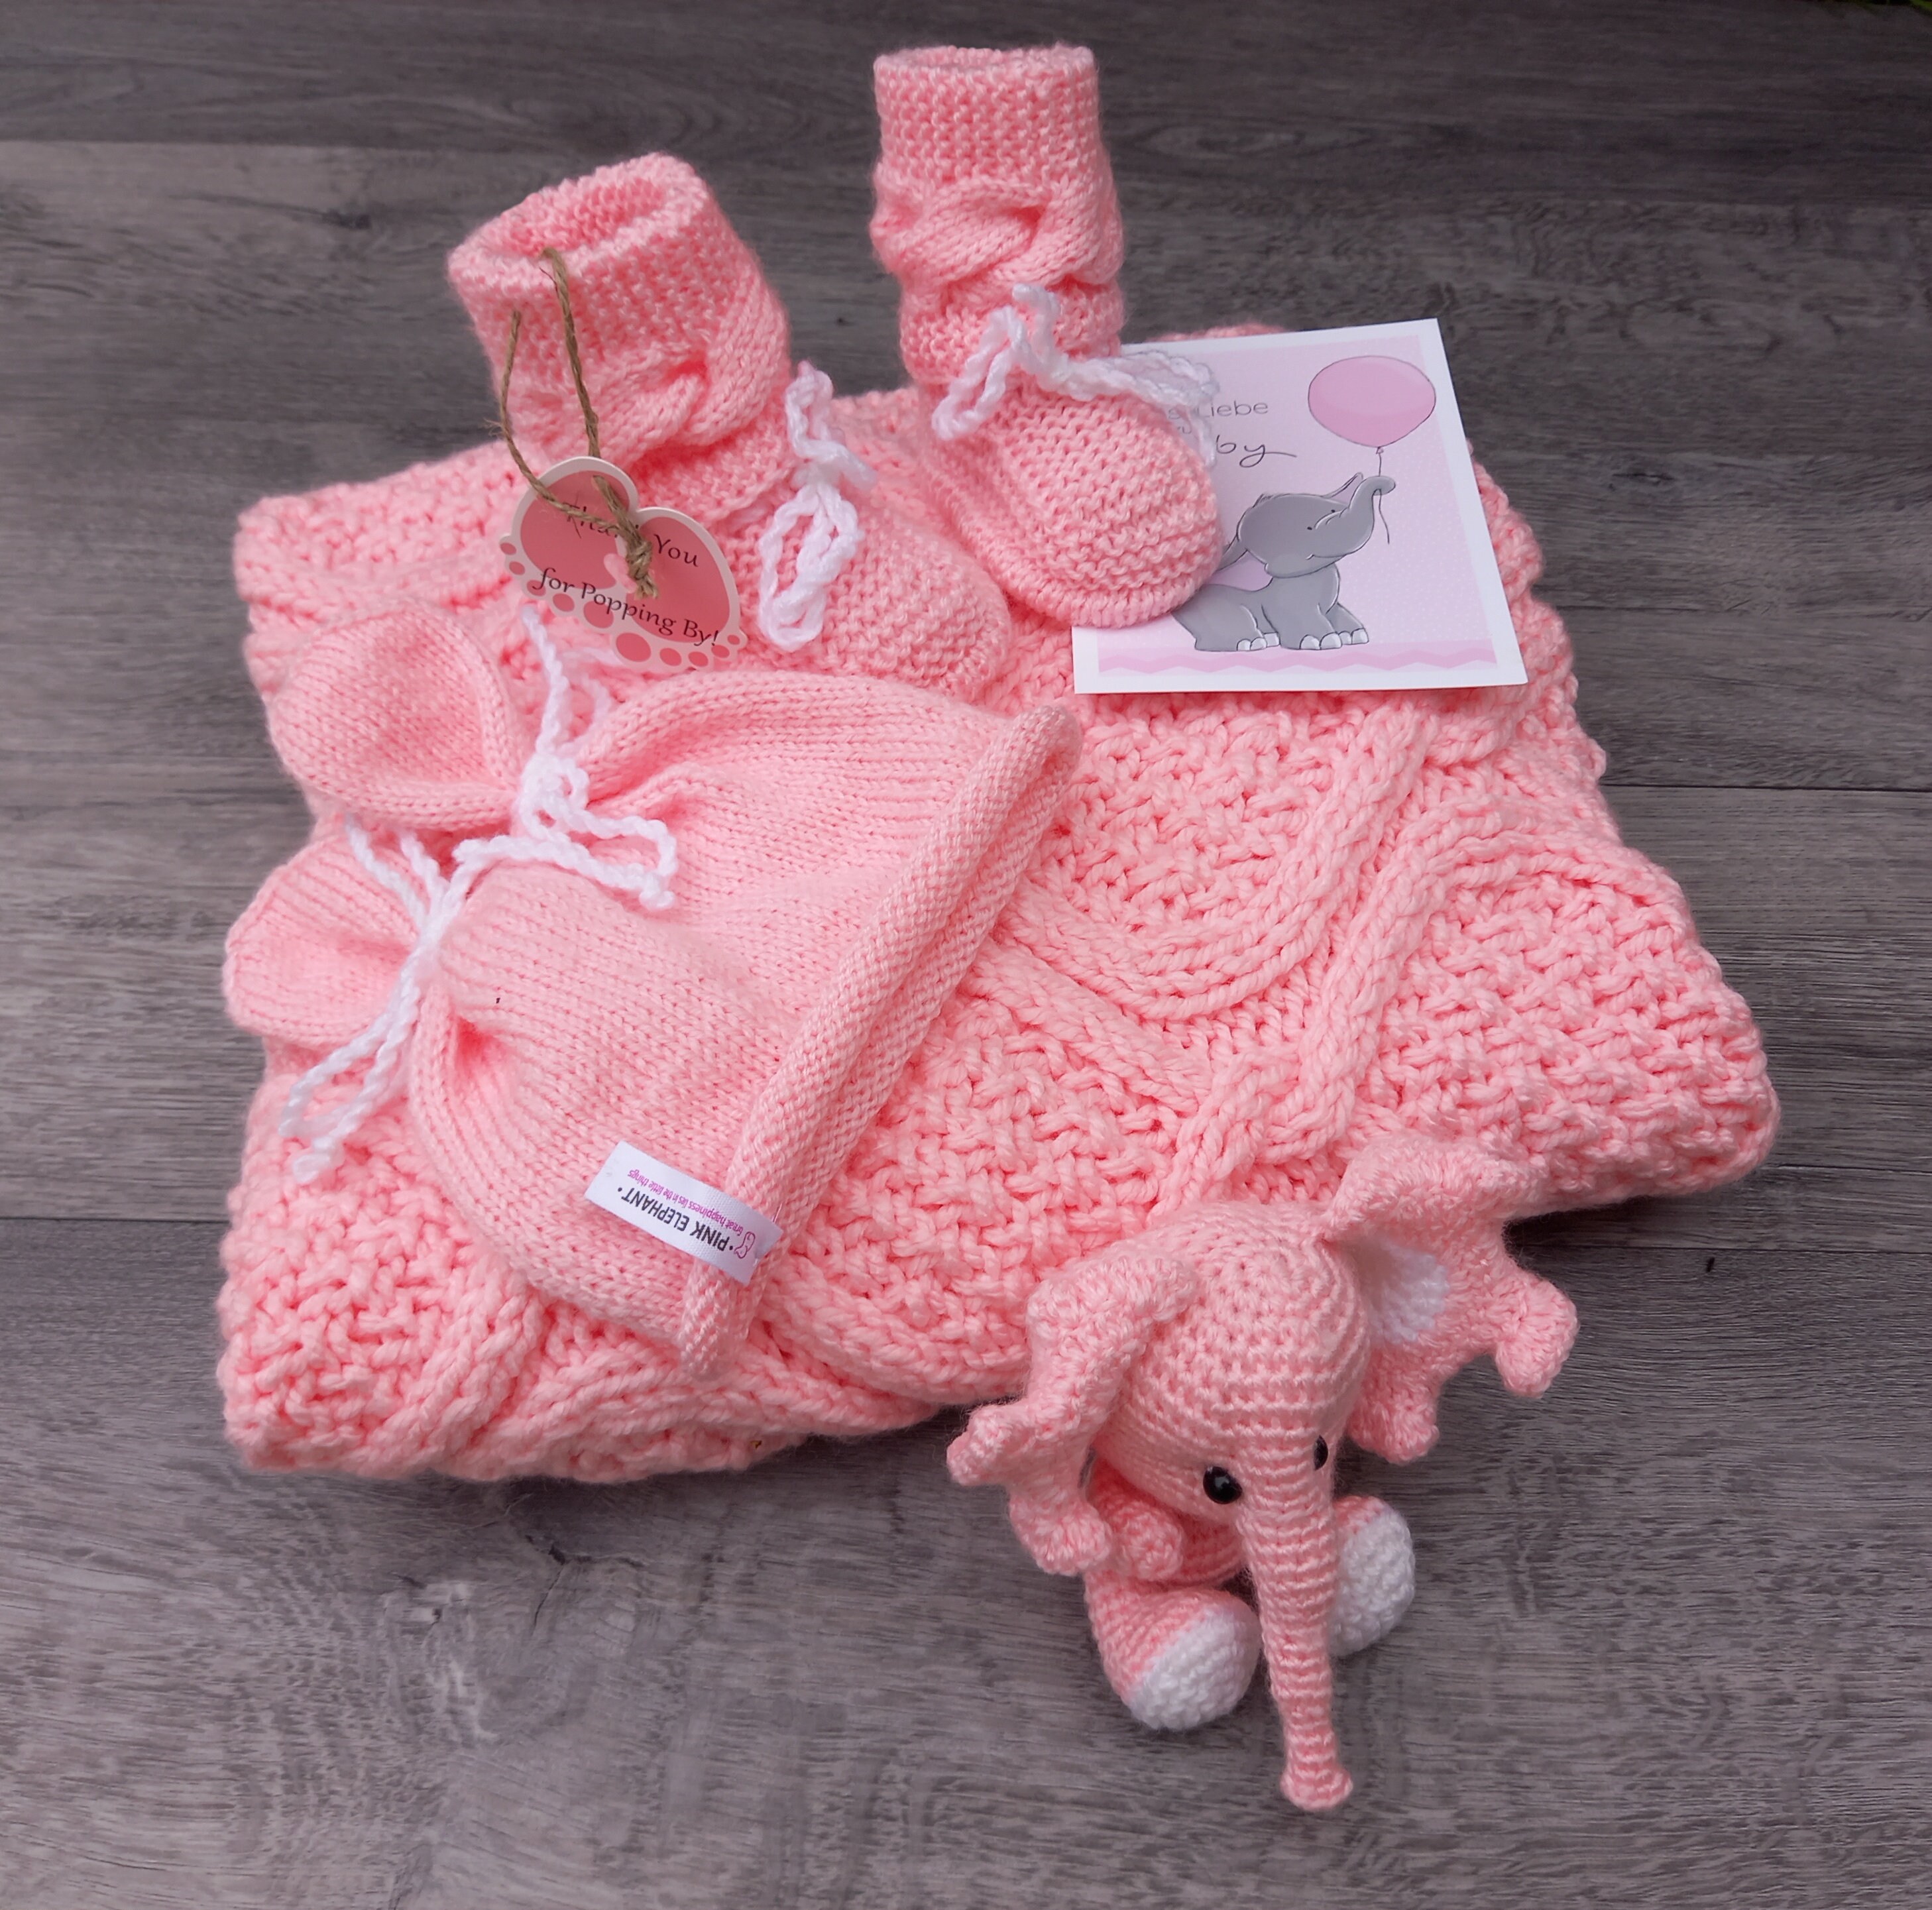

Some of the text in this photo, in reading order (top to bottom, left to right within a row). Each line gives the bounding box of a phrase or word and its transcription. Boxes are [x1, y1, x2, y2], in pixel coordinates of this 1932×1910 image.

[654, 534, 699, 567] You
[533, 567, 719, 646] for Popping By!
[622, 1188, 730, 1251] PINK ELEPHANT
[628, 1170, 743, 1237] Great happiness lies in the little things
